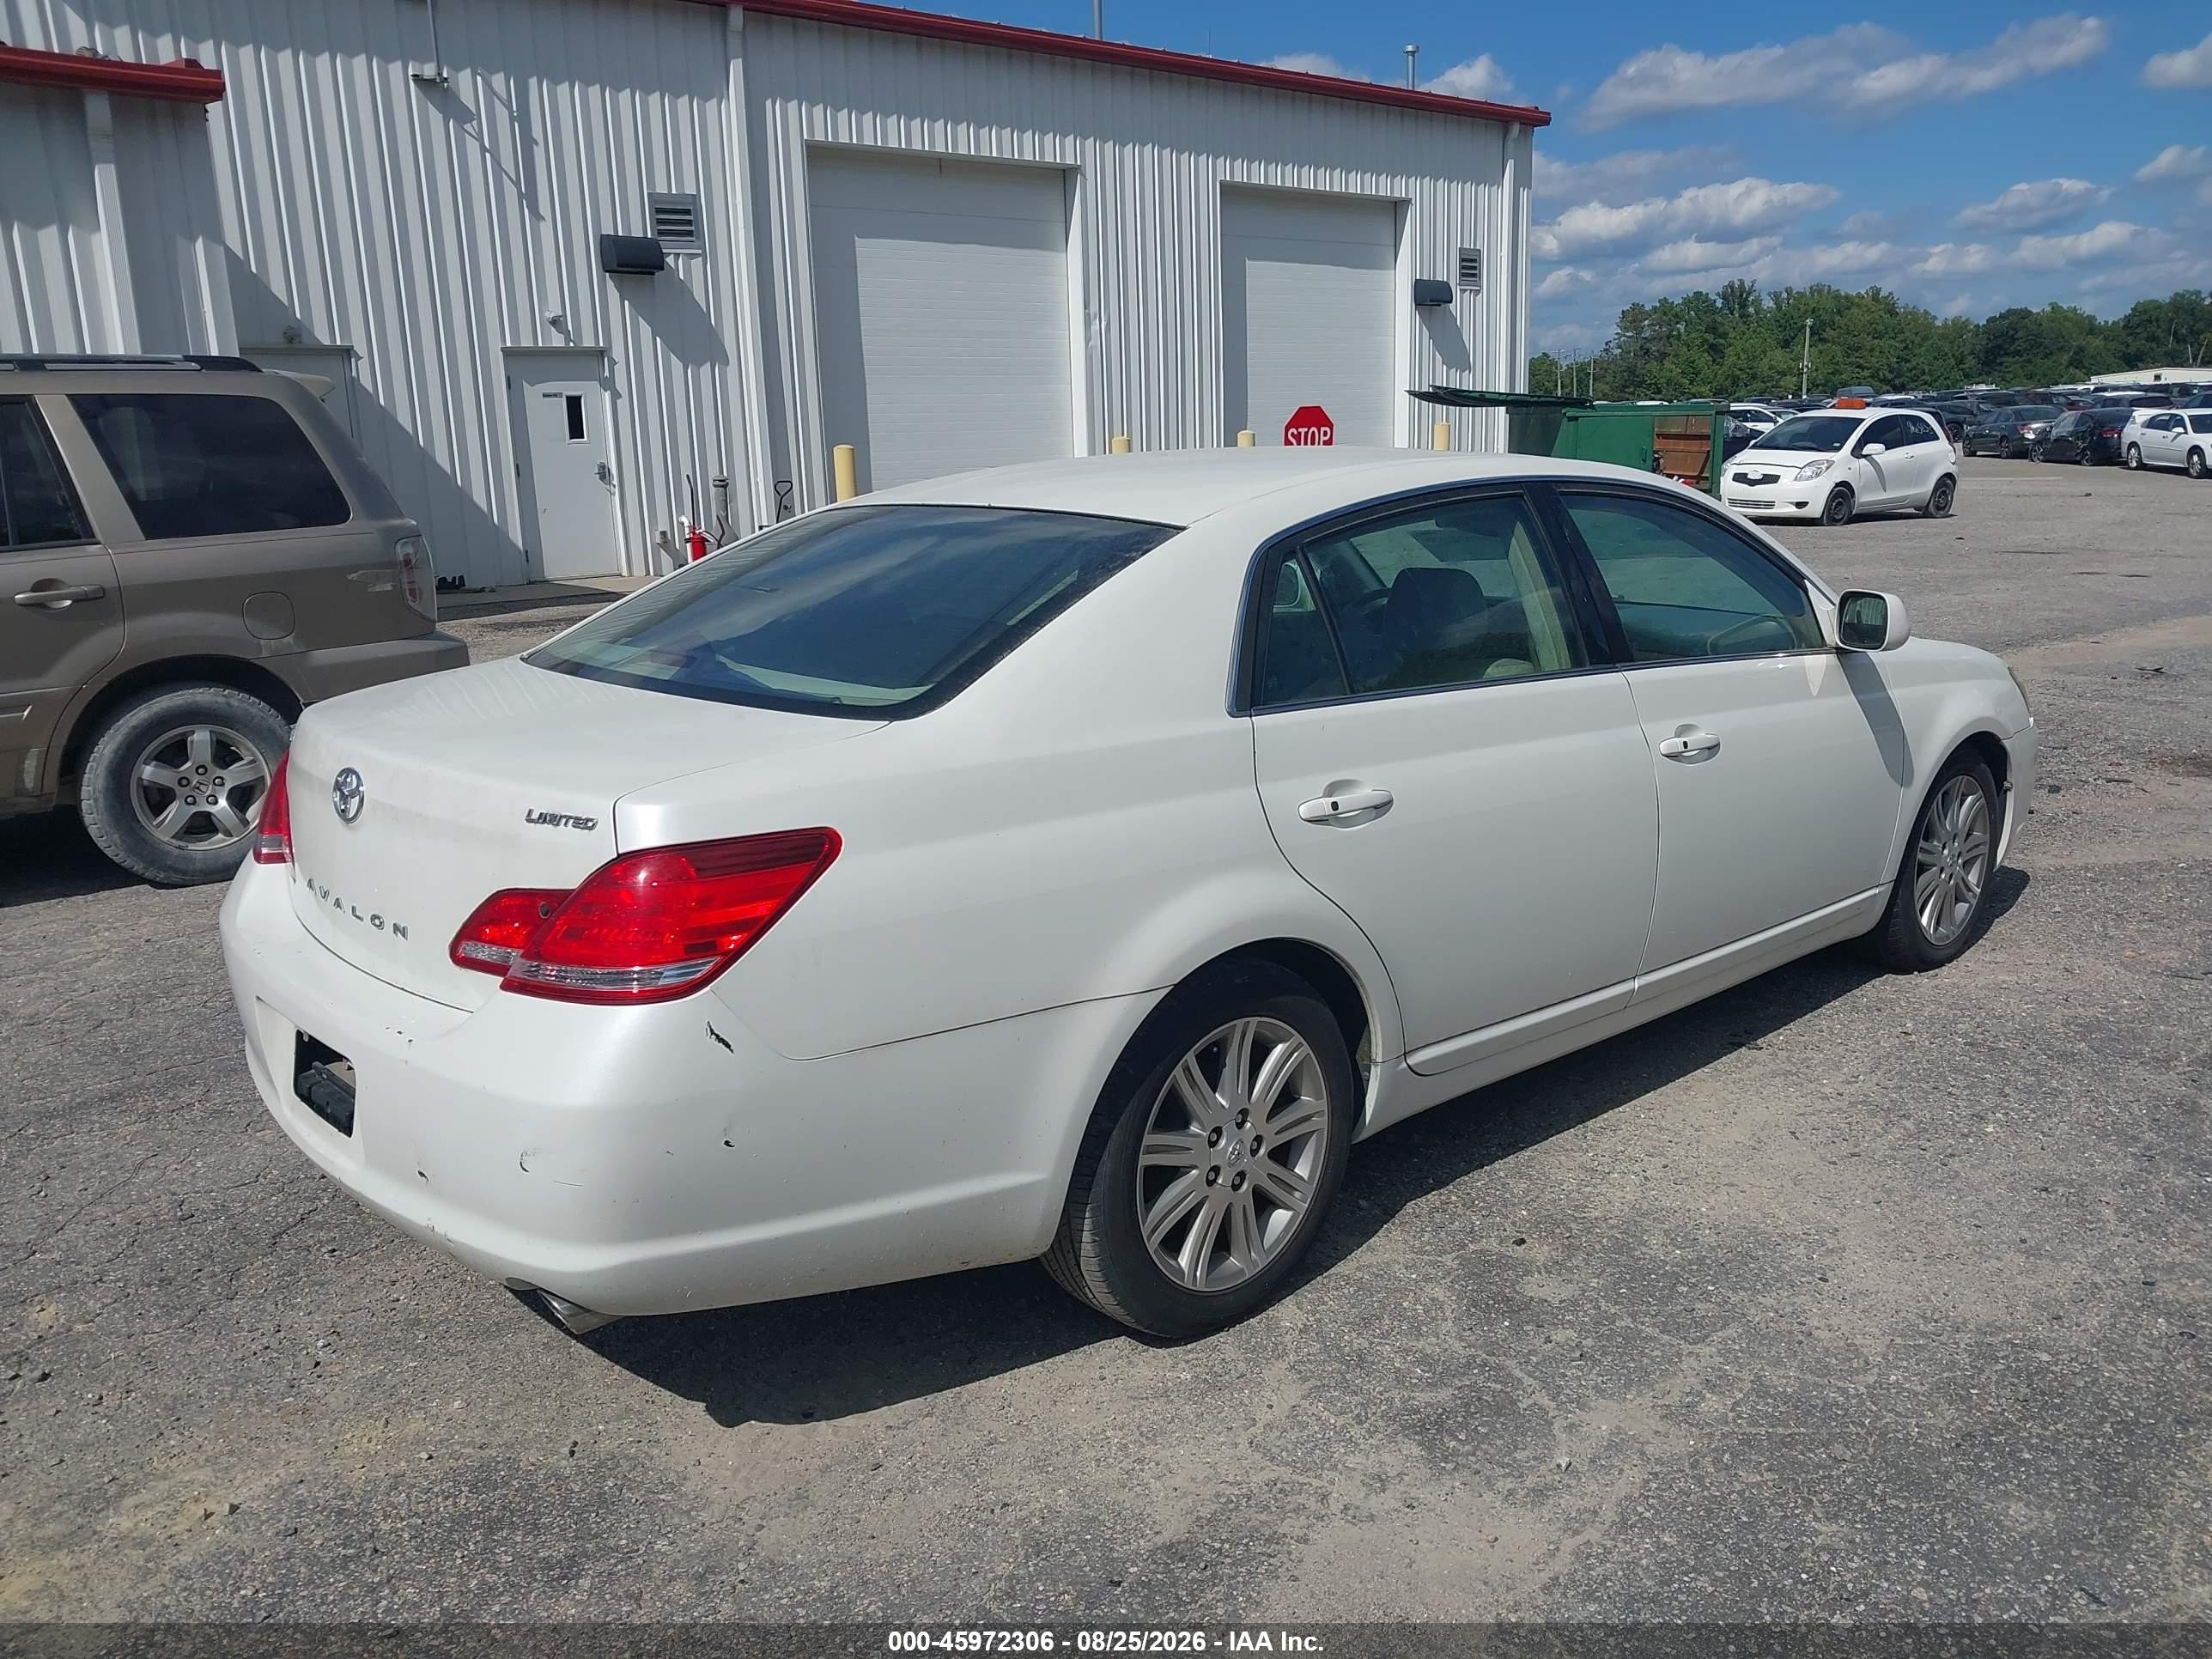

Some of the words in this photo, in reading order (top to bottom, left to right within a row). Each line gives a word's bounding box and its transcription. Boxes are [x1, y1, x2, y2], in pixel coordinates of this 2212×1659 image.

[1287, 426, 1331, 447] STOP
[525, 808, 599, 831] LIMITED
[307, 878, 409, 941] AVALON
